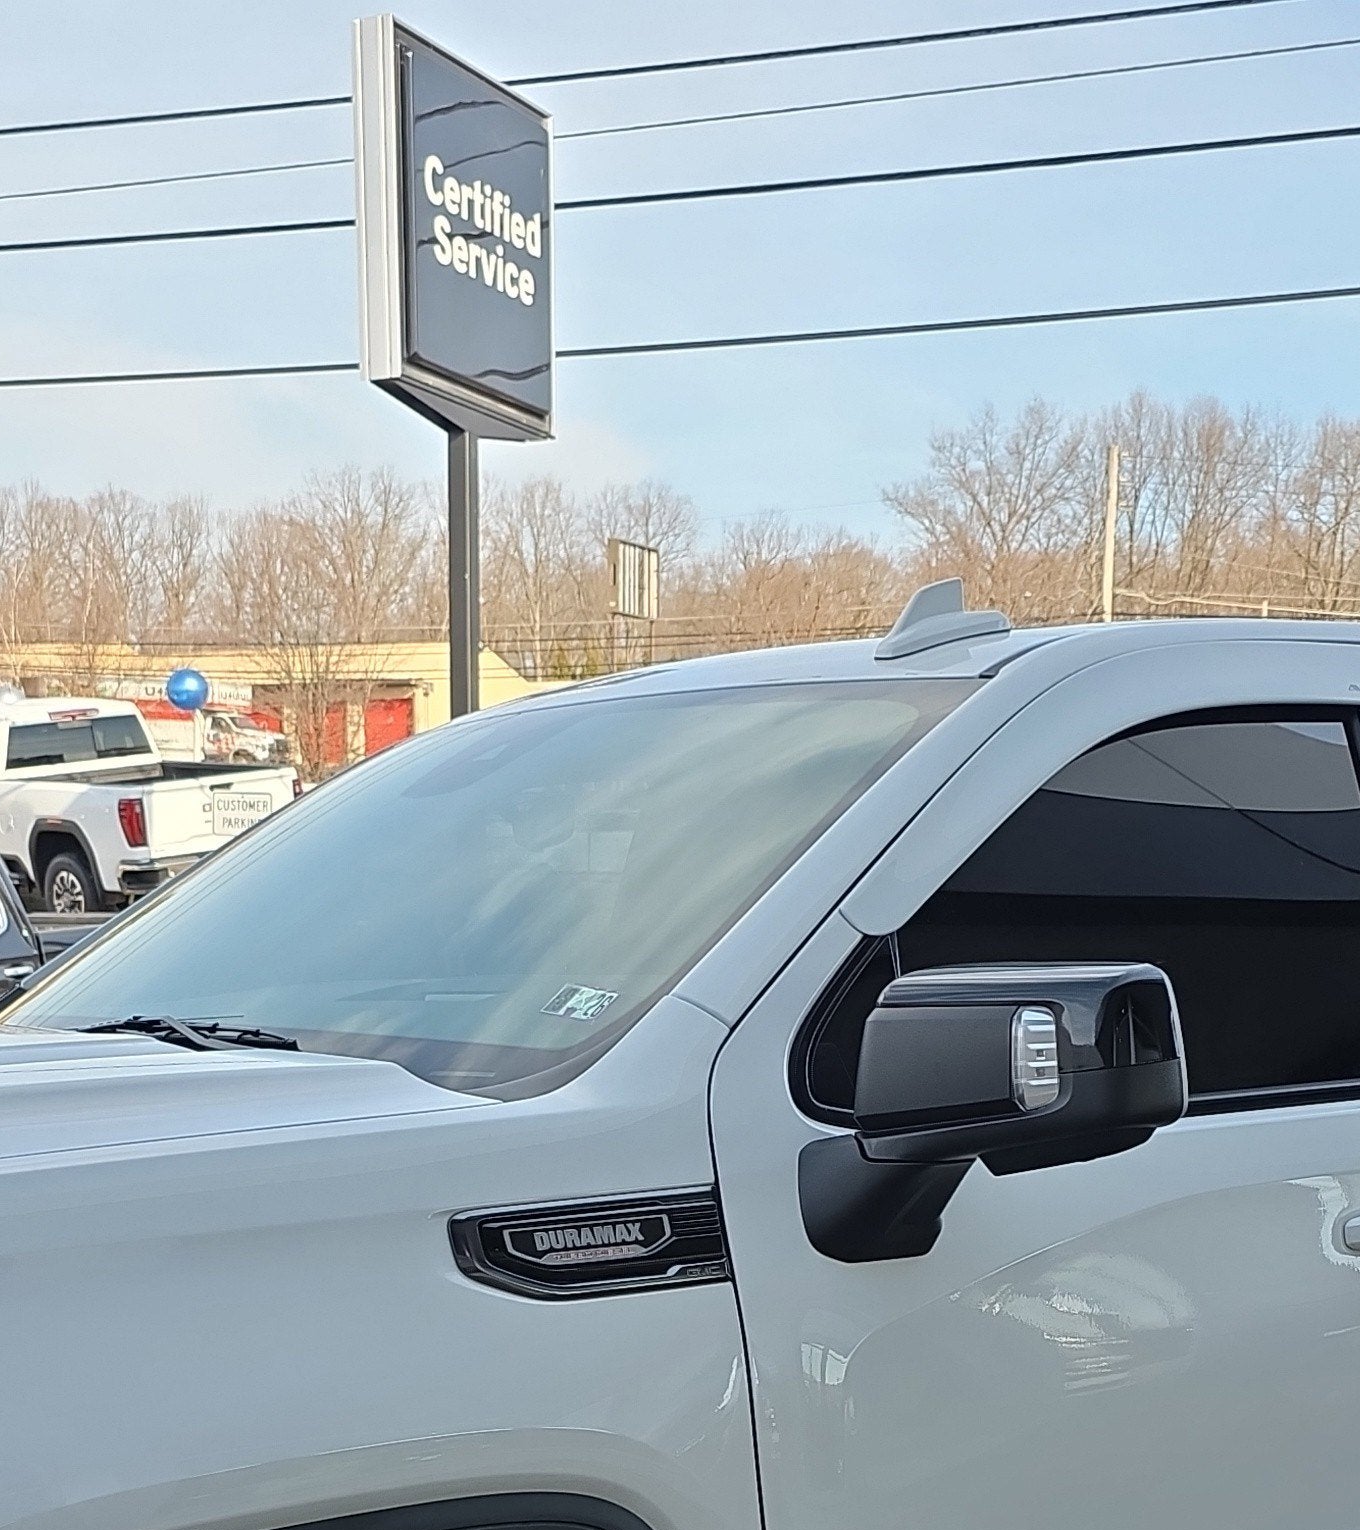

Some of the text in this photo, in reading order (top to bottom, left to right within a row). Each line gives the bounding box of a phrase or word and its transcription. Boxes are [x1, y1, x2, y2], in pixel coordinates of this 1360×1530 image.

[423, 155, 542, 259] Certified
[433, 216, 535, 306] Service
[217, 799, 269, 813] CUSTOMER
[223, 817, 260, 829] PARKIN
[533, 1221, 645, 1251] DURAMAX
